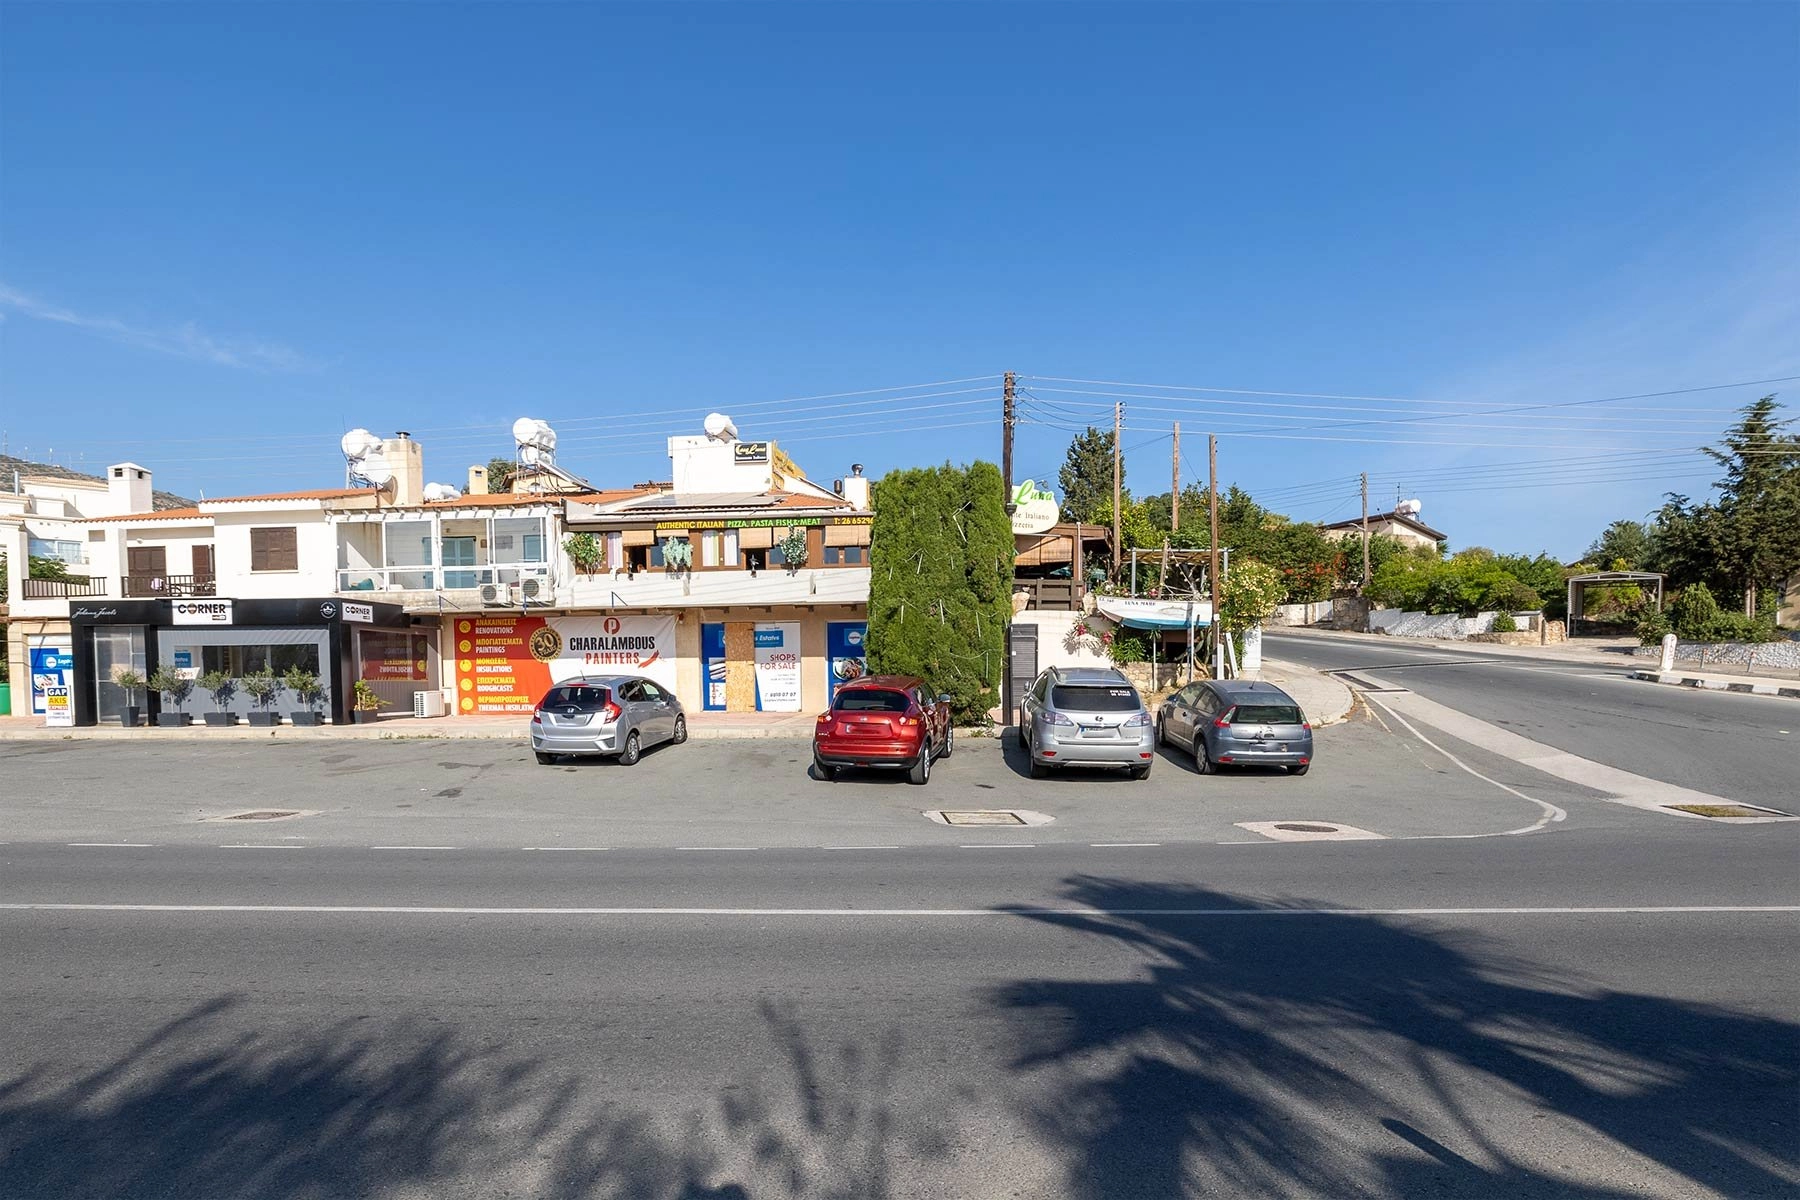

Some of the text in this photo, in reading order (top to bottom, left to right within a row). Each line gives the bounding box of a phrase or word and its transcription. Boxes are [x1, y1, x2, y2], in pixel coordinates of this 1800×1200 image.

[1015, 480, 1053, 505] Luna
[656, 521, 696, 530] AUTHENTIC
[696, 520, 725, 529] ITALIAN
[751, 519, 774, 527] PASTA
[841, 517, 851, 525] 26
[178, 603, 226, 615] CORNER
[345, 606, 370, 615] CORNER
[475, 626, 514, 634] RENOVATIONS
[535, 633, 555, 651] 30
[569, 636, 656, 651] CHARALAMBOUS
[475, 646, 506, 654] PAINTINGS
[585, 652, 640, 664] PAINTERS
[777, 662, 796, 670] SALE
[48, 688, 67, 696] GAP
